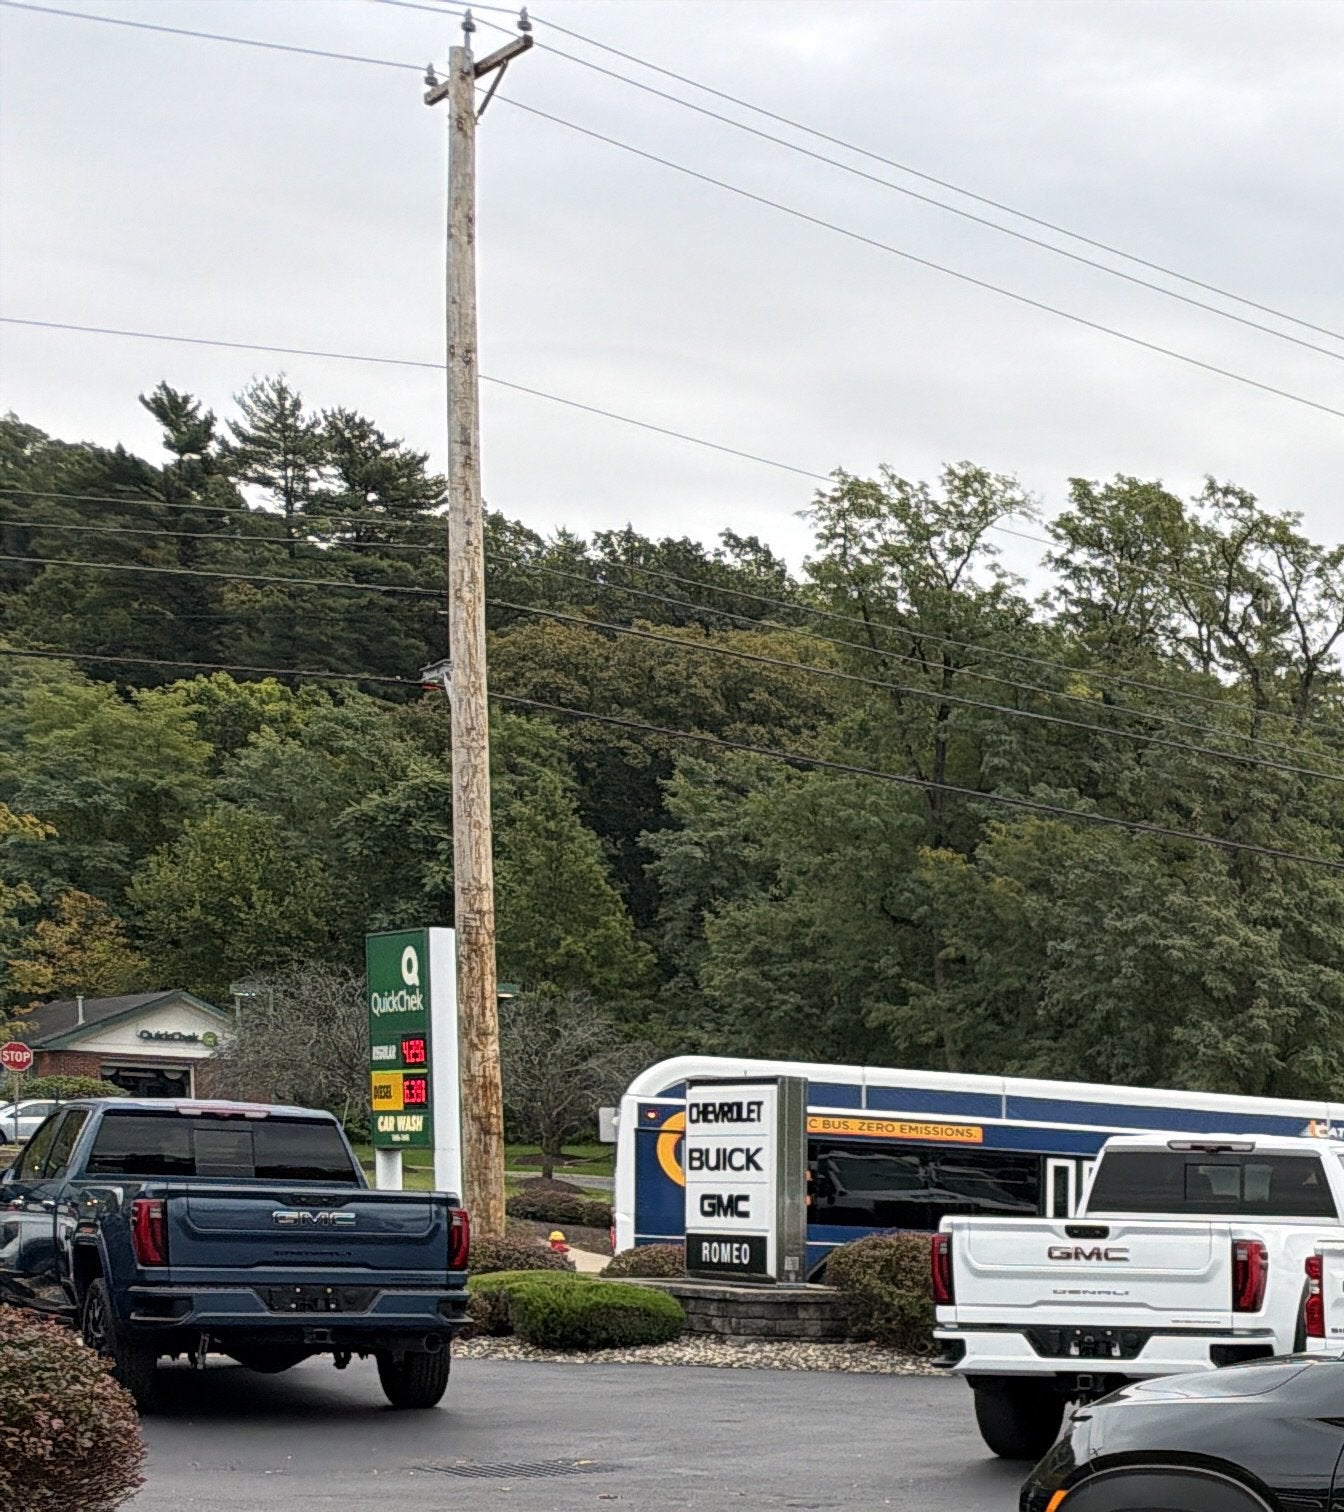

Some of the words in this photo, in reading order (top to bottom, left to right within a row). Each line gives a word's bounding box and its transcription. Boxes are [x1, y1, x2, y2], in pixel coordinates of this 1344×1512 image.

[402, 946, 419, 986] Q
[371, 989, 424, 1017] QuickChek
[2, 1050, 31, 1062] STOP
[378, 1116, 394, 1132] CAR
[397, 1115, 423, 1131] WASH
[689, 1101, 764, 1124] CHEVROLET
[822, 1119, 854, 1132] BUS.
[858, 1121, 896, 1134] ZERO
[900, 1124, 977, 1140] EMISSIONS.
[689, 1147, 764, 1171] BUICK
[700, 1193, 750, 1219] GMC
[272, 1210, 357, 1227] GMC
[702, 1242, 750, 1265] ROMEO
[1047, 1246, 1131, 1263] GMC
